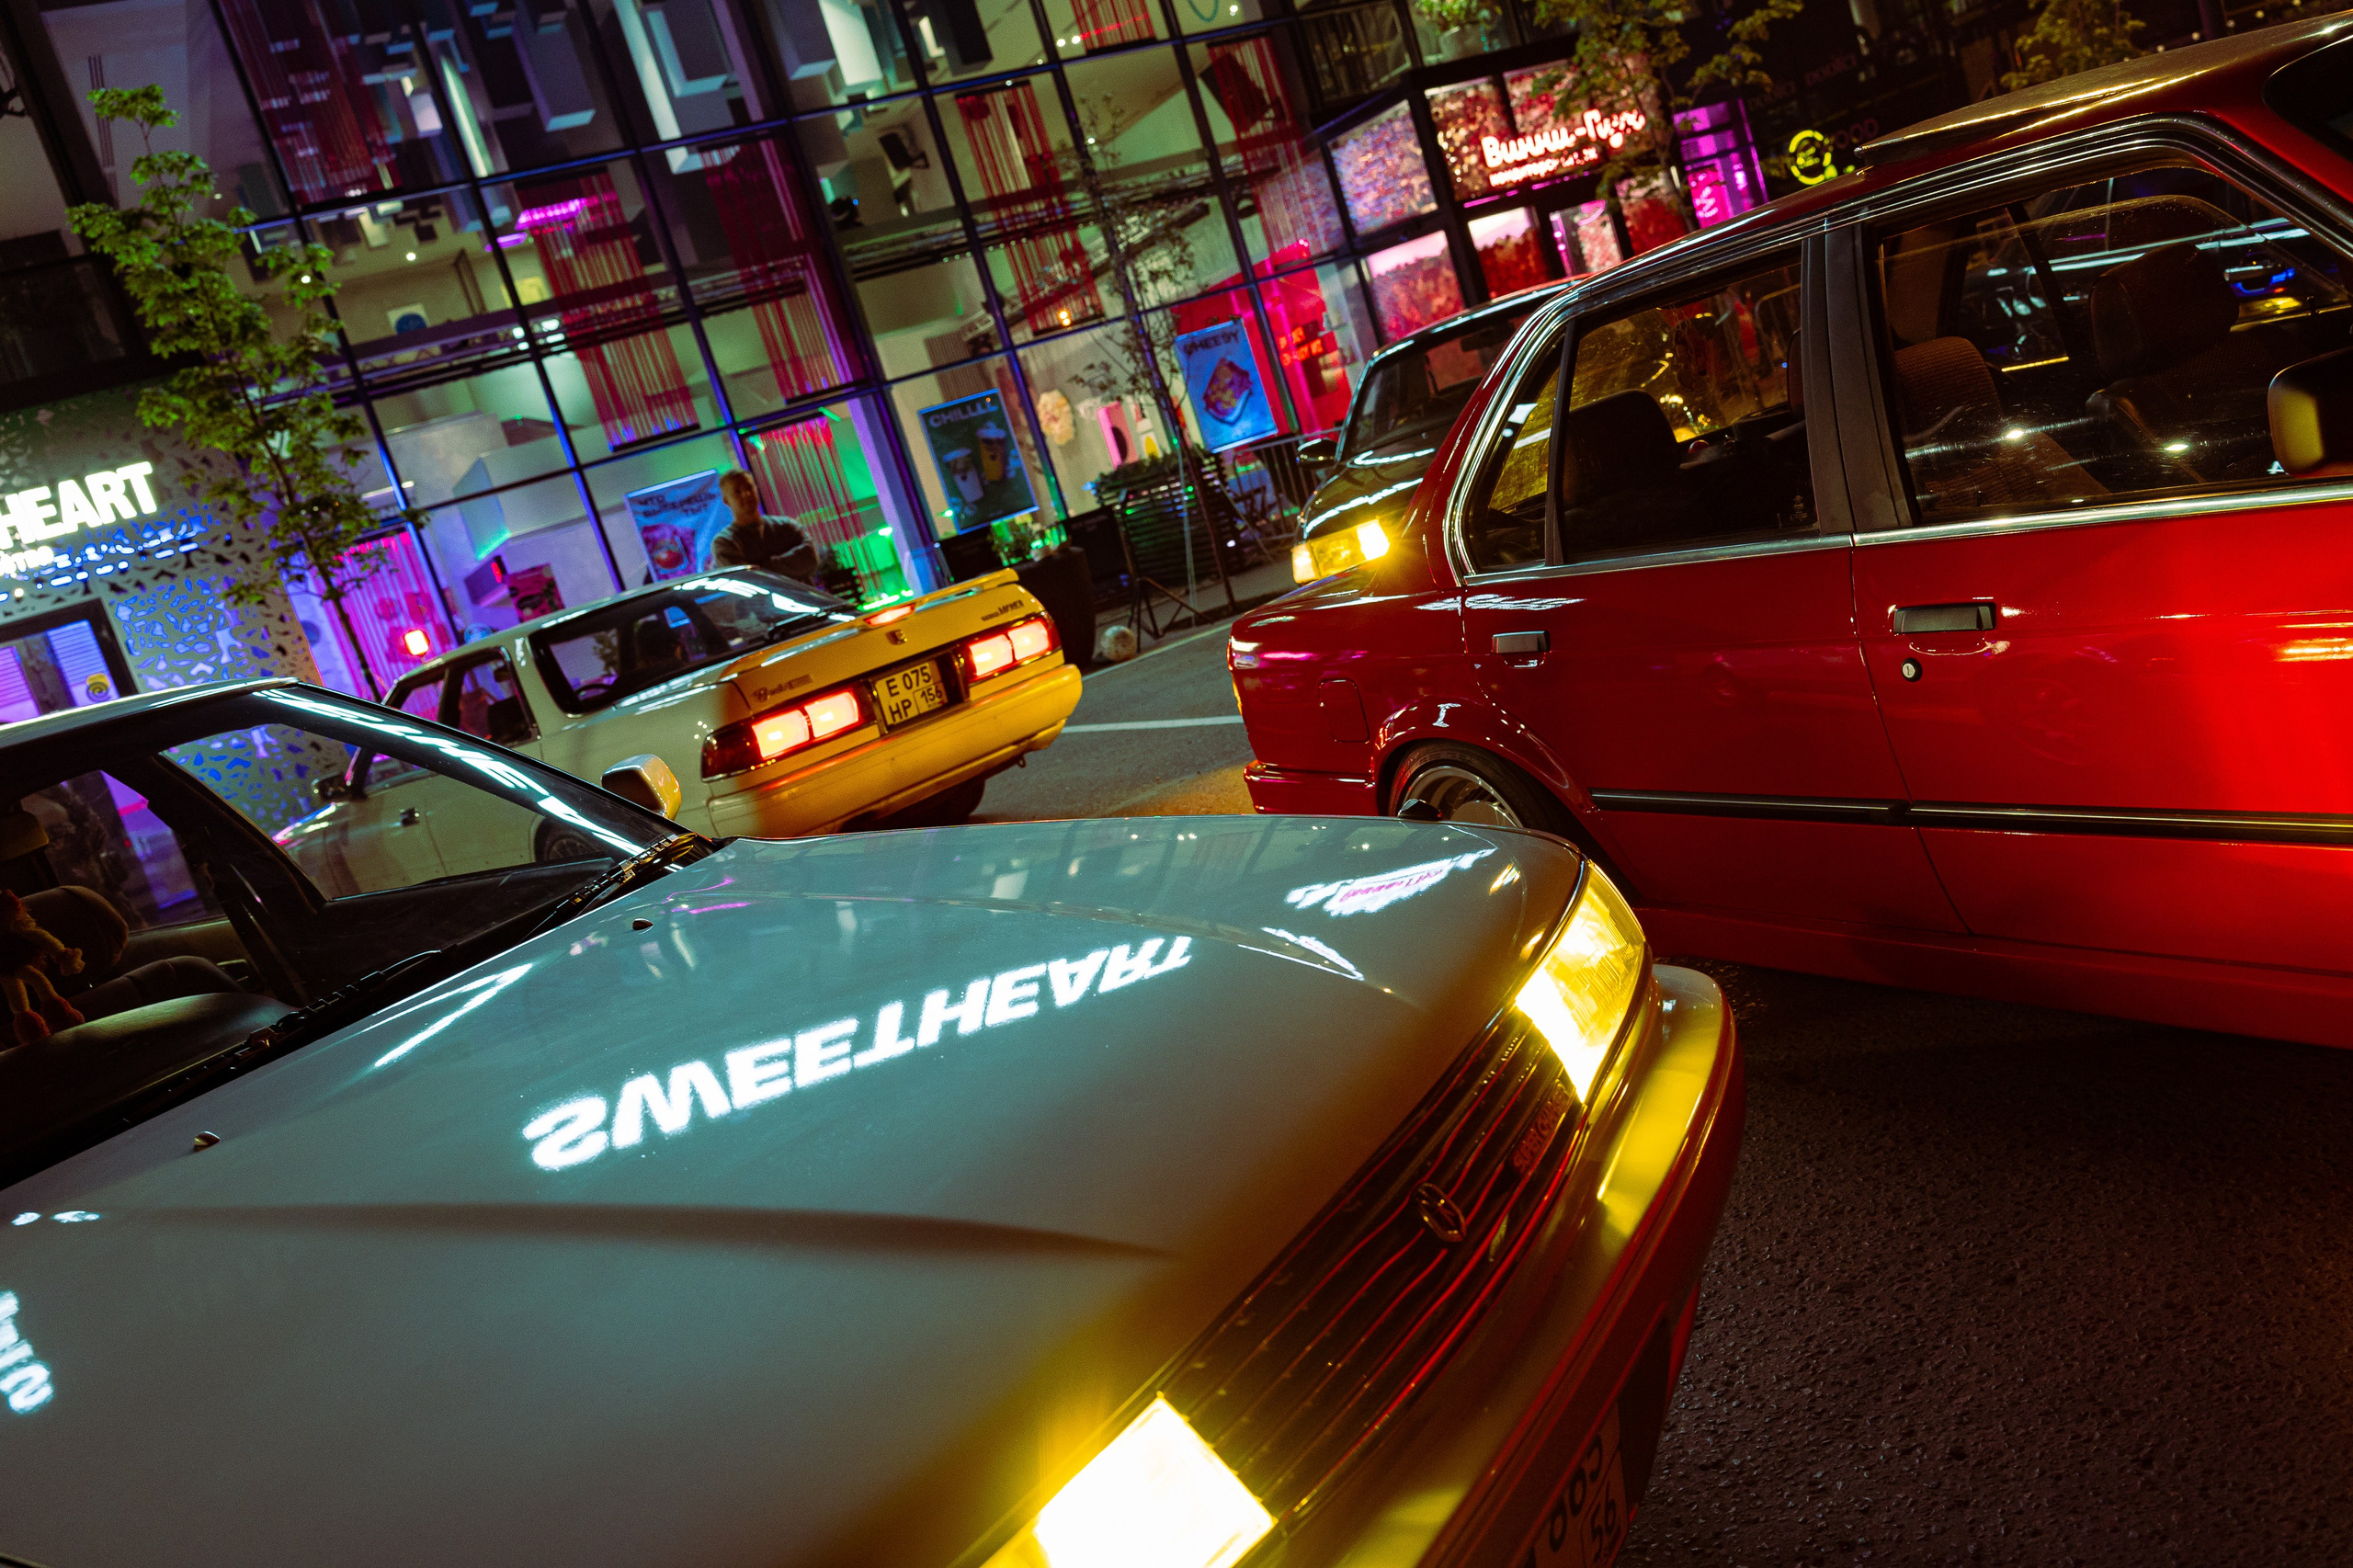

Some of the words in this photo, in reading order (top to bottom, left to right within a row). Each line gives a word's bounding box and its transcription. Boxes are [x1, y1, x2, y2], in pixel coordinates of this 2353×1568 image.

[0, 461, 157, 550] HEART
[886, 677, 900, 698] E
[902, 665, 932, 690] 075
[888, 699, 912, 723] HP
[920, 686, 943, 704] 156
